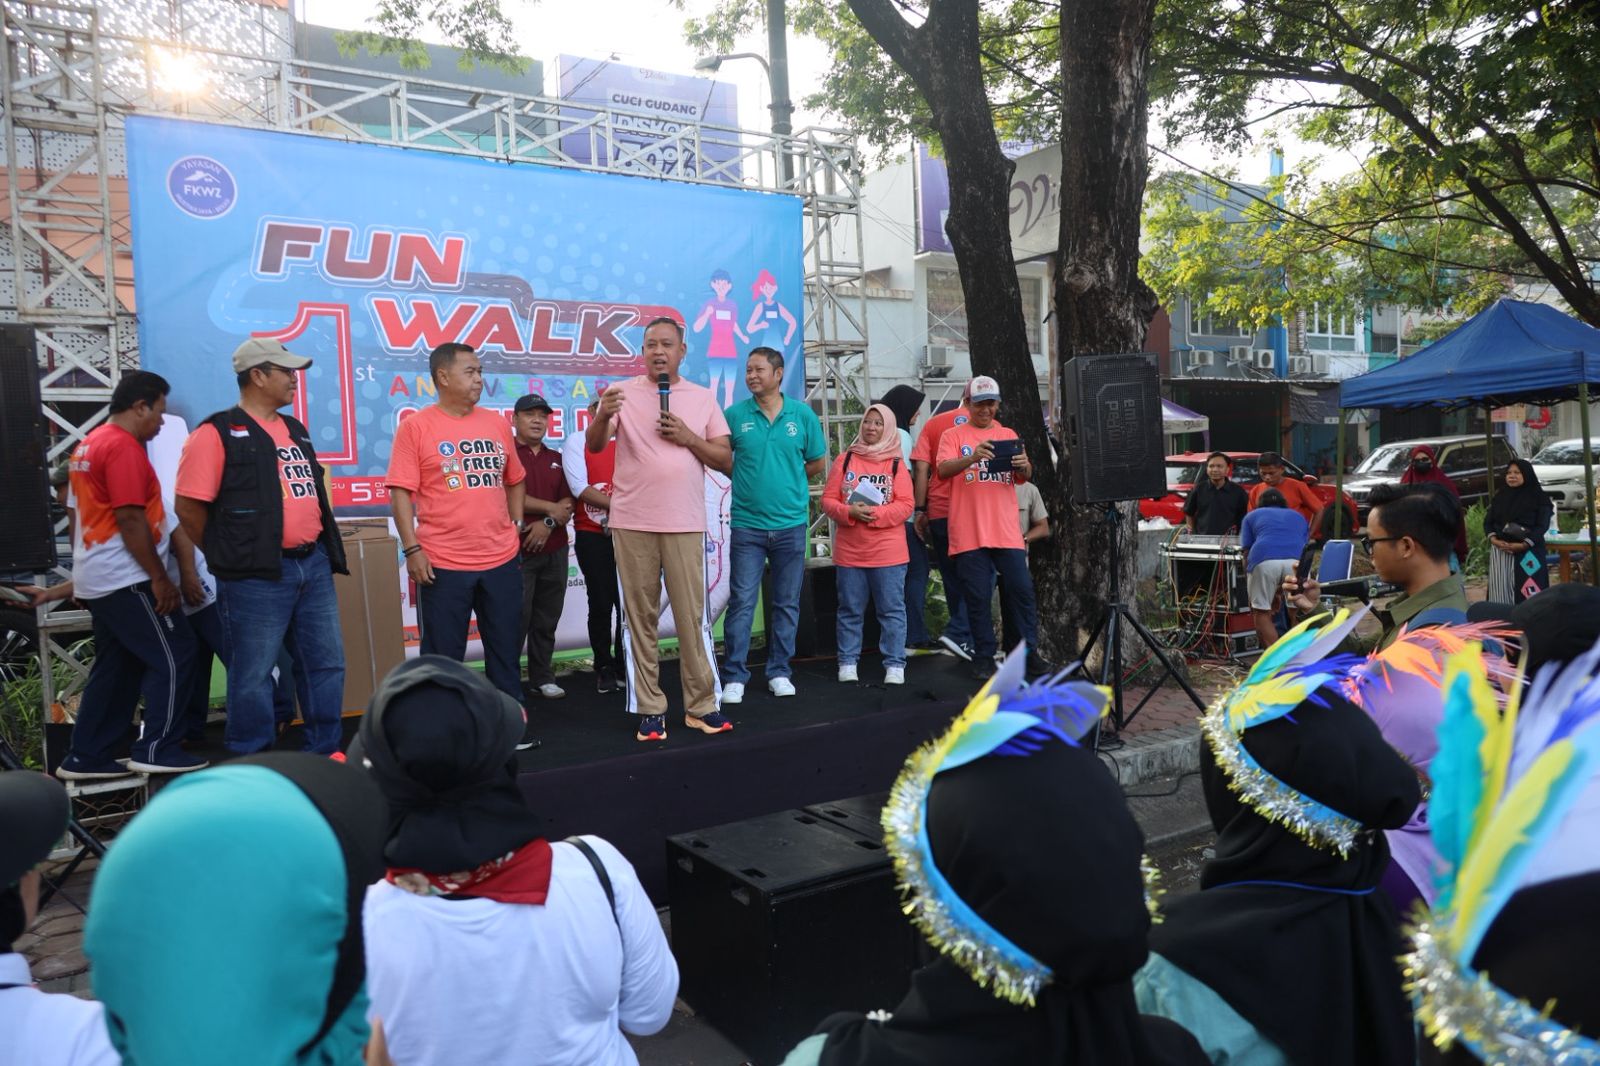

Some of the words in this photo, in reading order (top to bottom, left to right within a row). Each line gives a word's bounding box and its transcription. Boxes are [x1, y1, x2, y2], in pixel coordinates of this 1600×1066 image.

[612, 94, 642, 107] CUCI
[645, 99, 697, 116] GUDANG
[183, 184, 222, 198] FKWZ
[257, 221, 465, 288] FUN
[371, 298, 639, 358] WALK
[277, 446, 308, 462] CA
[458, 439, 496, 455] CAR
[284, 464, 313, 480] FRE
[462, 456, 501, 472] FREE
[465, 472, 499, 489] DAY
[351, 482, 372, 502] 5
